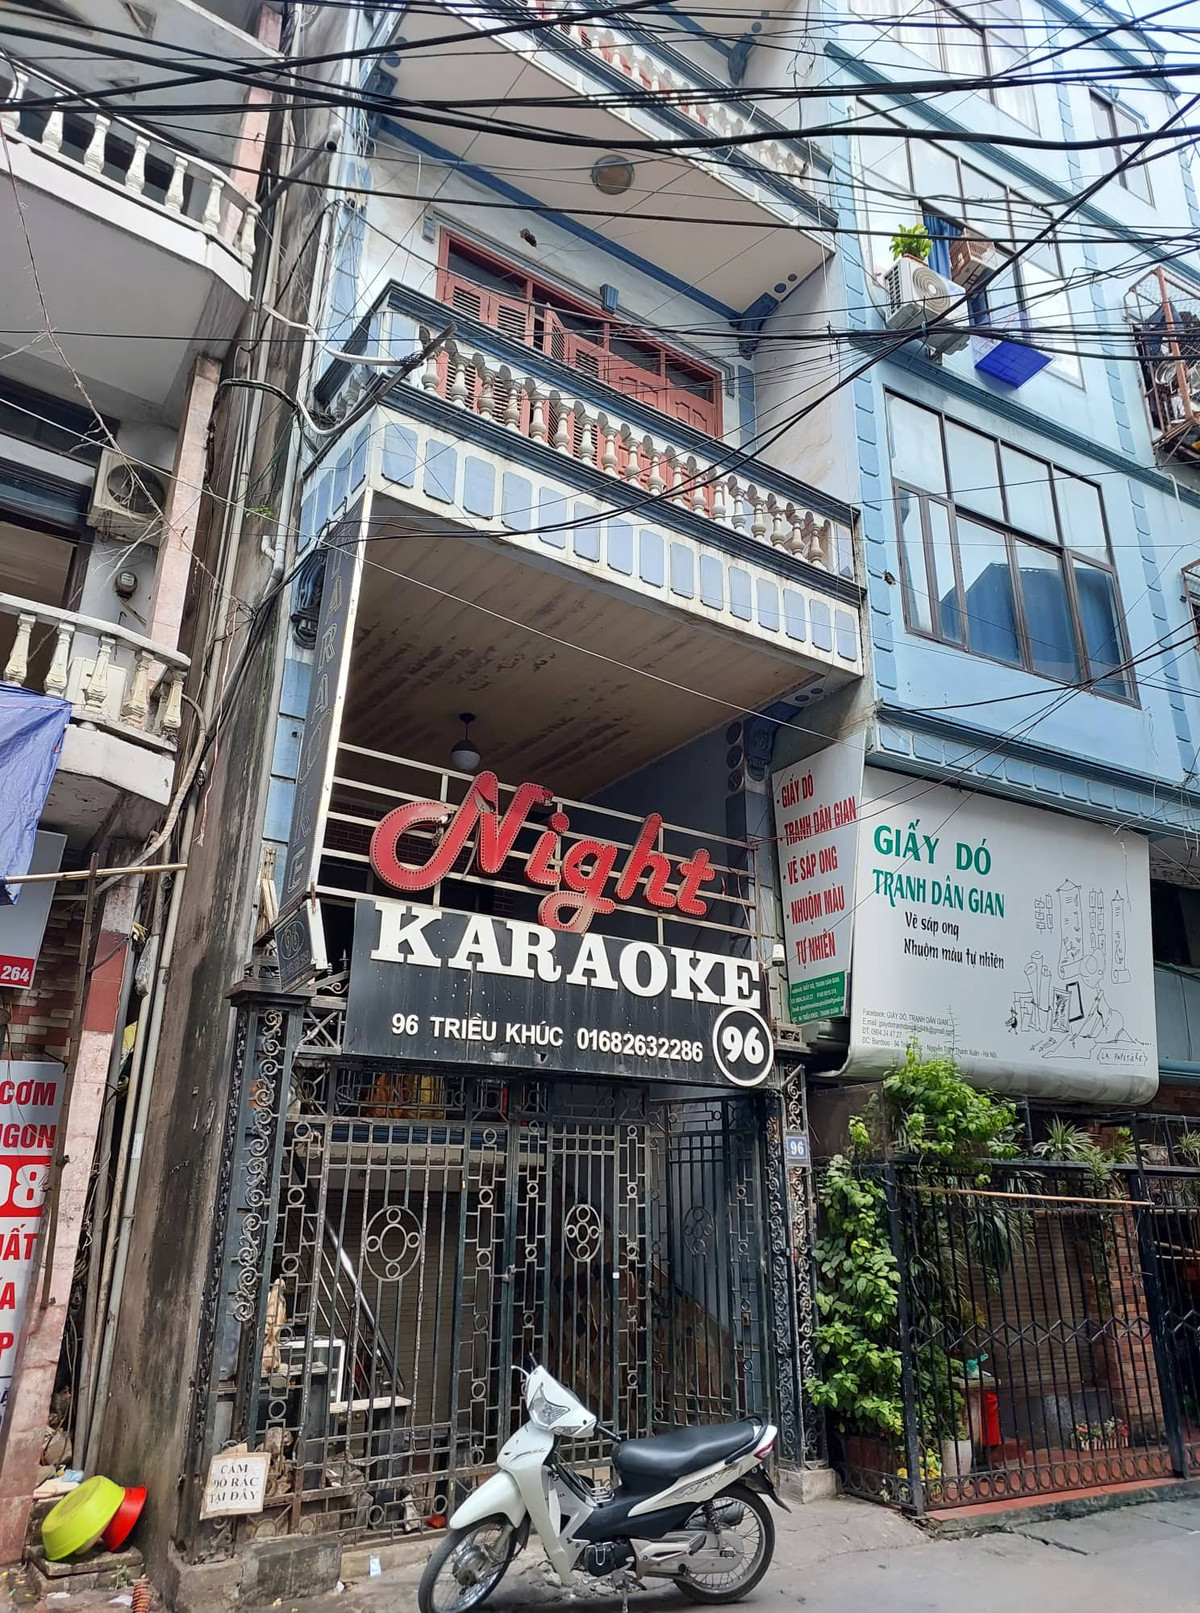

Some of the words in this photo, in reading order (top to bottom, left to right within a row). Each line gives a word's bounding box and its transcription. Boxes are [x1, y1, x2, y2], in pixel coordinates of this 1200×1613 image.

[802, 769, 814, 799] DÓ
[784, 815, 812, 846] TRANH
[813, 804, 832, 833] DÂN
[833, 796, 857, 826] GIAN
[370, 771, 715, 935] Night
[800, 850, 816, 881] SÁP
[819, 845, 838, 875] ONG
[874, 819, 940, 864] GIẤY
[956, 838, 992, 876] DÓ
[791, 890, 822, 925] NHUỘM
[823, 882, 845, 915] MÀU
[872, 868, 926, 907] TRANH
[931, 874, 964, 911] DÂN
[968, 887, 1005, 918] GIAN
[808, 928, 836, 962] NHIÊN
[921, 916, 939, 937] sáp
[370, 902, 761, 1009] KARAOKE
[904, 938, 938, 960] Nhuộm
[942, 947, 963, 963] màu
[966, 948, 977, 968] tự
[979, 951, 1004, 969] nhiên
[392, 1013, 419, 1036] 96
[430, 1012, 497, 1042] TRIỀU
[505, 1021, 564, 1047] KHÚC
[577, 1027, 704, 1063] 01682632286
[721, 1026, 765, 1065] 96
[0, 1079, 57, 1106] CƠM
[0, 1123, 57, 1149] GON
[790, 1140, 805, 1156] 96
